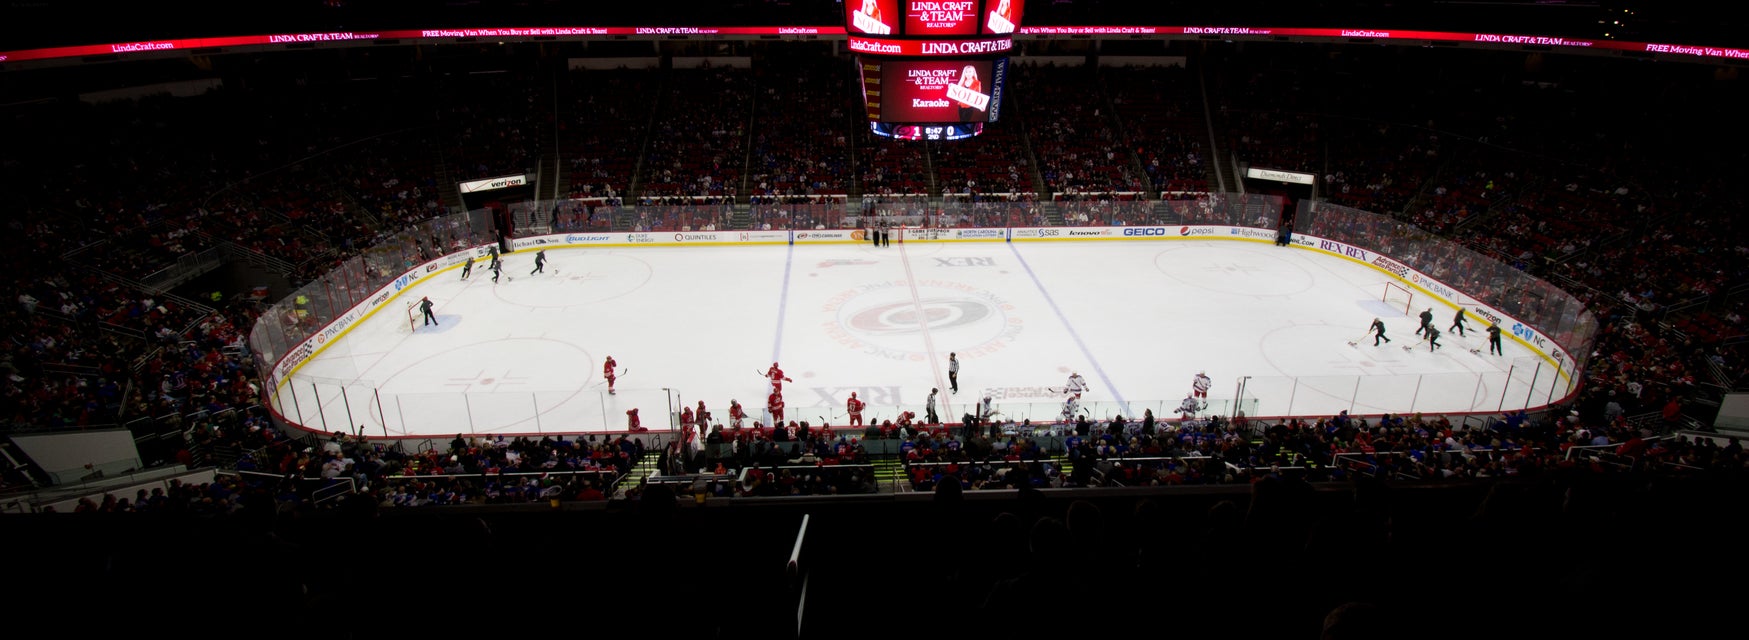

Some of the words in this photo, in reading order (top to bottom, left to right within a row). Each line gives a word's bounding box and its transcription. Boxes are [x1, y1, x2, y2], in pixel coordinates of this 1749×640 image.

[911, 1, 940, 11] LINDA
[942, 1, 973, 11] CRAFT
[919, 11, 929, 21] &
[930, 11, 963, 21] TEAM
[440, 29, 464, 37] Moving
[1341, 30, 1389, 38] LindaCraft.com
[269, 34, 296, 43] LINDA
[1475, 34, 1501, 43] LINDA
[112, 41, 174, 53] LindaCraft.com
[850, 39, 901, 53] LindaCraft.com
[921, 43, 958, 54] LINDA
[1646, 43, 1669, 52] FREE
[1670, 45, 1703, 56] Moving
[1705, 47, 1723, 56] Van
[908, 69, 931, 77] LINDA
[932, 69, 957, 77] CRAFT
[914, 77, 922, 85] &
[922, 77, 949, 85] TEAM
[951, 87, 983, 106] SOLD
[912, 98, 949, 108] Karaoke
[913, 126, 921, 137] 1
[946, 126, 954, 136] 0
[491, 178, 522, 188] verizon
[1123, 228, 1165, 236] GEICO
[1190, 227, 1214, 236] pepsi
[1320, 240, 1344, 254] REX
[1345, 246, 1368, 261] REX
[934, 256, 997, 267] REX
[408, 271, 419, 282] NC
[1475, 307, 1502, 324] verizon
[1533, 335, 1545, 349] NC
[809, 385, 902, 407] REX
